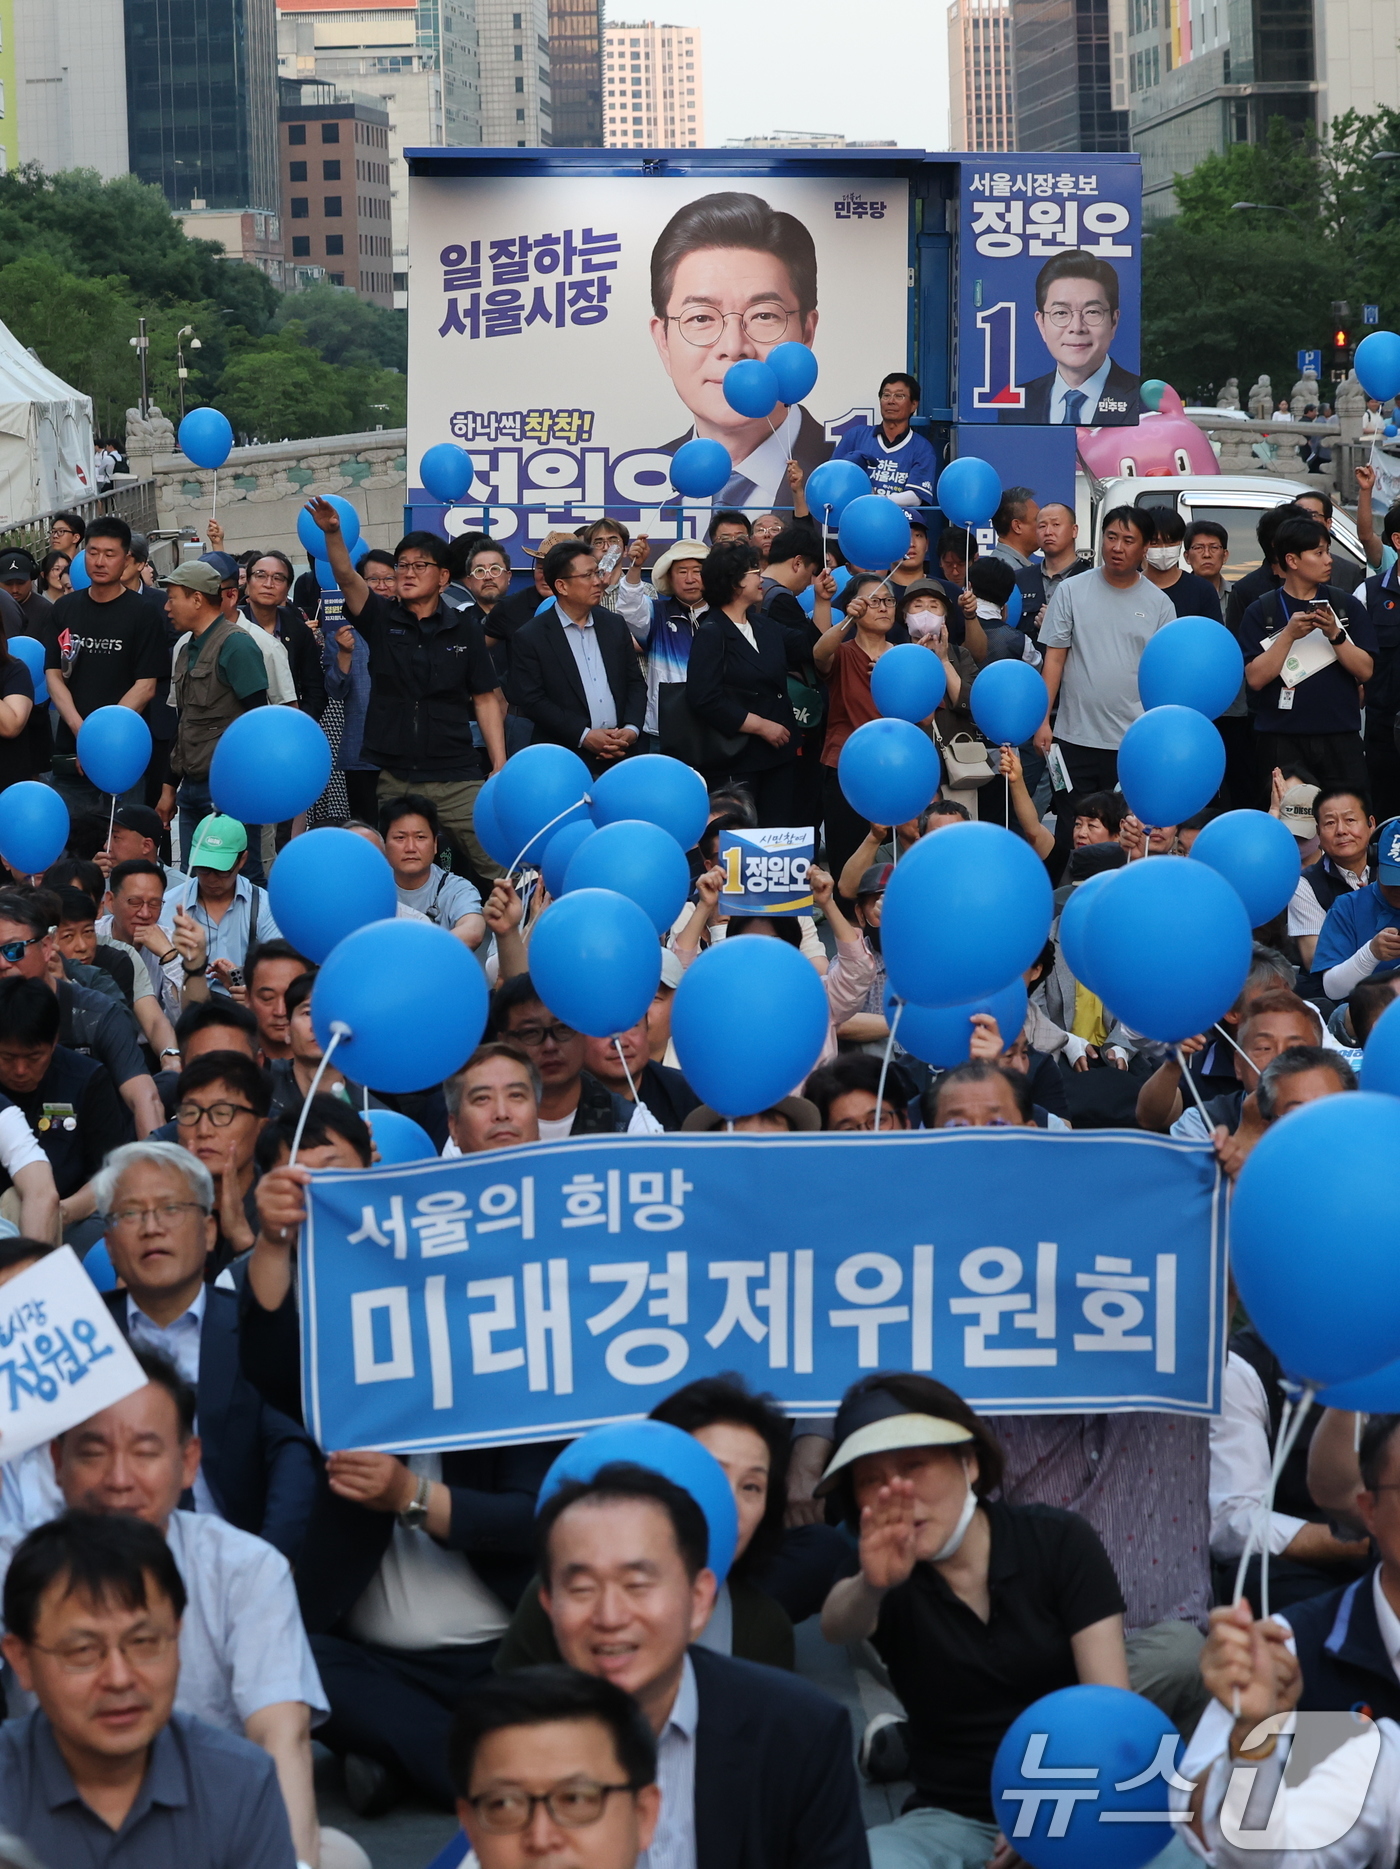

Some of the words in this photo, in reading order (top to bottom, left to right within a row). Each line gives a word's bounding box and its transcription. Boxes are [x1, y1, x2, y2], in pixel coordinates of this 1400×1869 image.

[834, 201, 887, 219] 민주당
[969, 172, 1099, 197] 서울시장후보
[971, 201, 1132, 257] 정원오
[439, 240, 482, 292] 일
[488, 227, 622, 286] 잘하는
[438, 276, 612, 340] 서울시장
[973, 302, 1024, 408] 1
[1305, 351, 1314, 364] P
[451, 411, 522, 441] 하나씩
[523, 409, 594, 444] 착착!
[444, 452, 700, 541] 정원오
[870, 470, 909, 484] 서울시장
[722, 846, 745, 894] 1
[745, 856, 812, 892] 정원오
[347, 1176, 535, 1260] 서울의
[561, 1168, 694, 1234] 희망
[0, 1298, 47, 1347] 시장
[351, 1242, 1177, 1410] 미래경제위원회
[0, 1318, 114, 1411] 정원오
